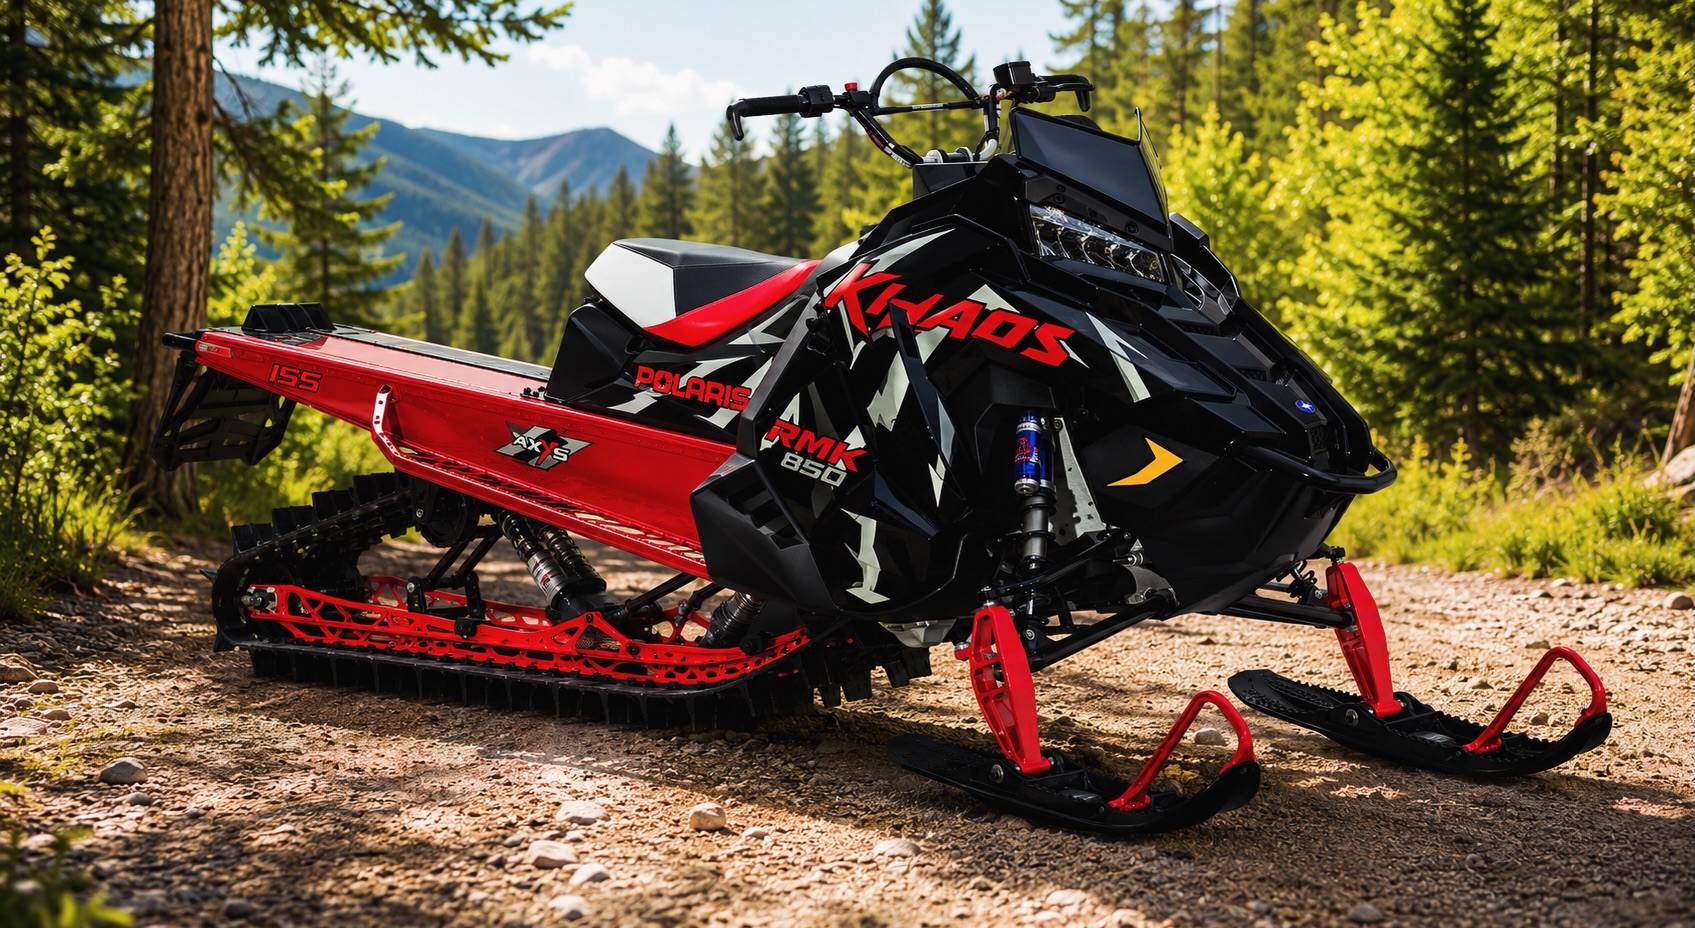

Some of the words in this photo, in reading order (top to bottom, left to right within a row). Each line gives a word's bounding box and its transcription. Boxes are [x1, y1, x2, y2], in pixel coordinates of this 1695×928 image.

[824, 262, 1076, 367] KHAOS
[269, 364, 322, 392] 155
[633, 365, 751, 411] POLARIS
[512, 433, 570, 465] AXYS
[766, 418, 868, 473] RMK
[780, 451, 847, 487] 850
